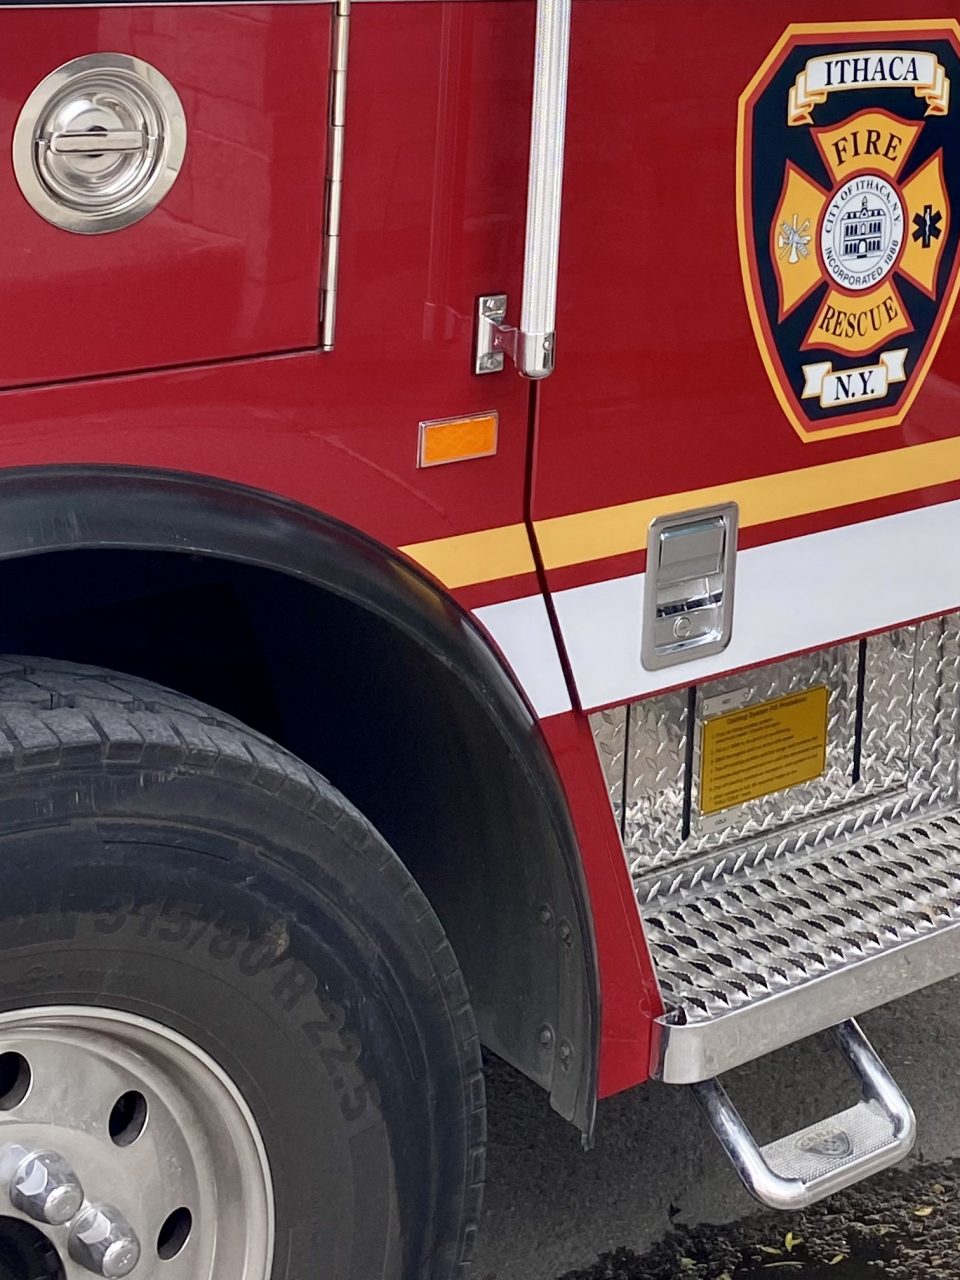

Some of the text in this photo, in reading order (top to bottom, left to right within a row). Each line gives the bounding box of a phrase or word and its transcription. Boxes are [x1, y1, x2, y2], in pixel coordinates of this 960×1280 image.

[824, 56, 919, 86] ITHACA
[831, 128, 903, 166] FIRE
[825, 201, 840, 233] CITY
[840, 186, 853, 201] OF
[855, 179, 891, 203] ITHACA,
[824, 239, 899, 286] INCORPORATED 1888
[818, 295, 899, 338] RESCUE
[834, 370, 875, 401] N.Y.
